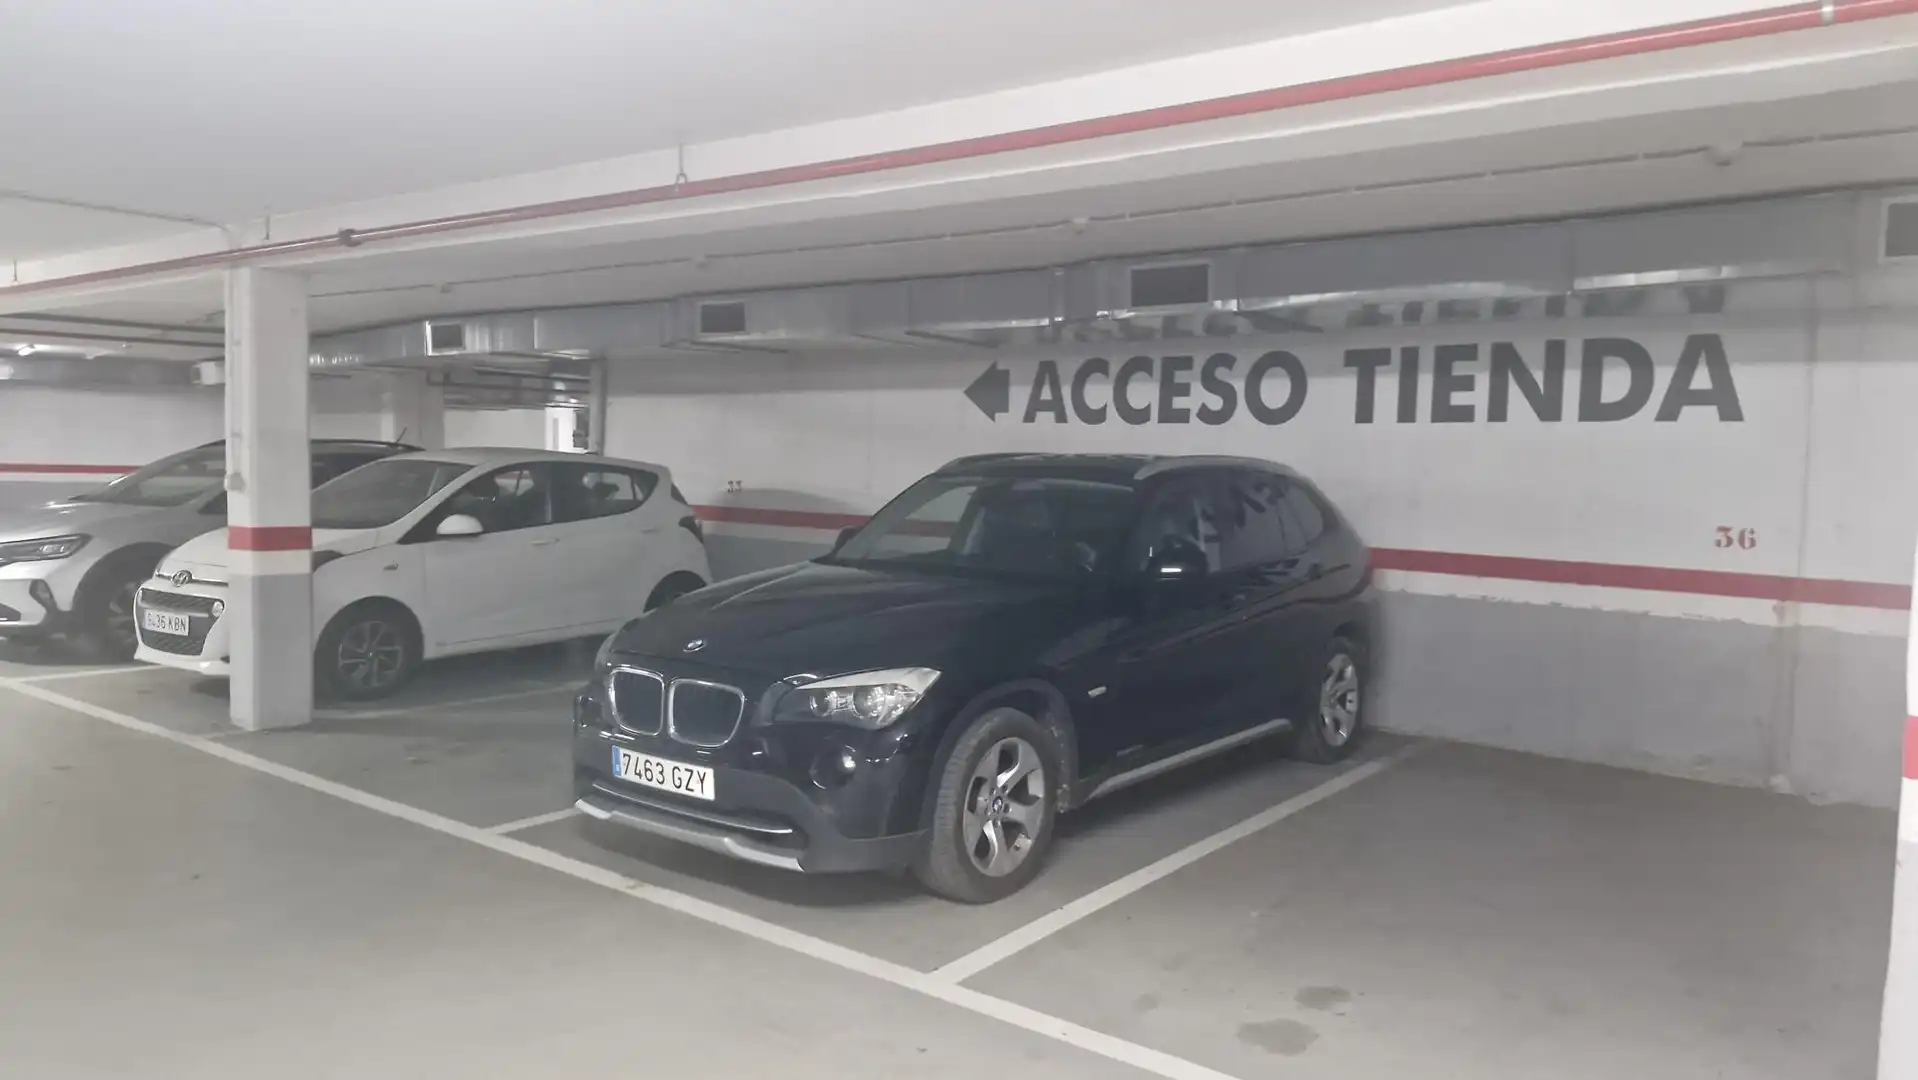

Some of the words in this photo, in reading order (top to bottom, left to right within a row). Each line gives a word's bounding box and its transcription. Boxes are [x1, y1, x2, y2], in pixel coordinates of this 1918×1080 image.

[1022, 350, 1308, 426] ACCESO
[1343, 333, 1745, 424] TIENDA
[1714, 525, 1757, 550] 36
[622, 752, 666, 785] 7463
[671, 765, 707, 795] GZY
